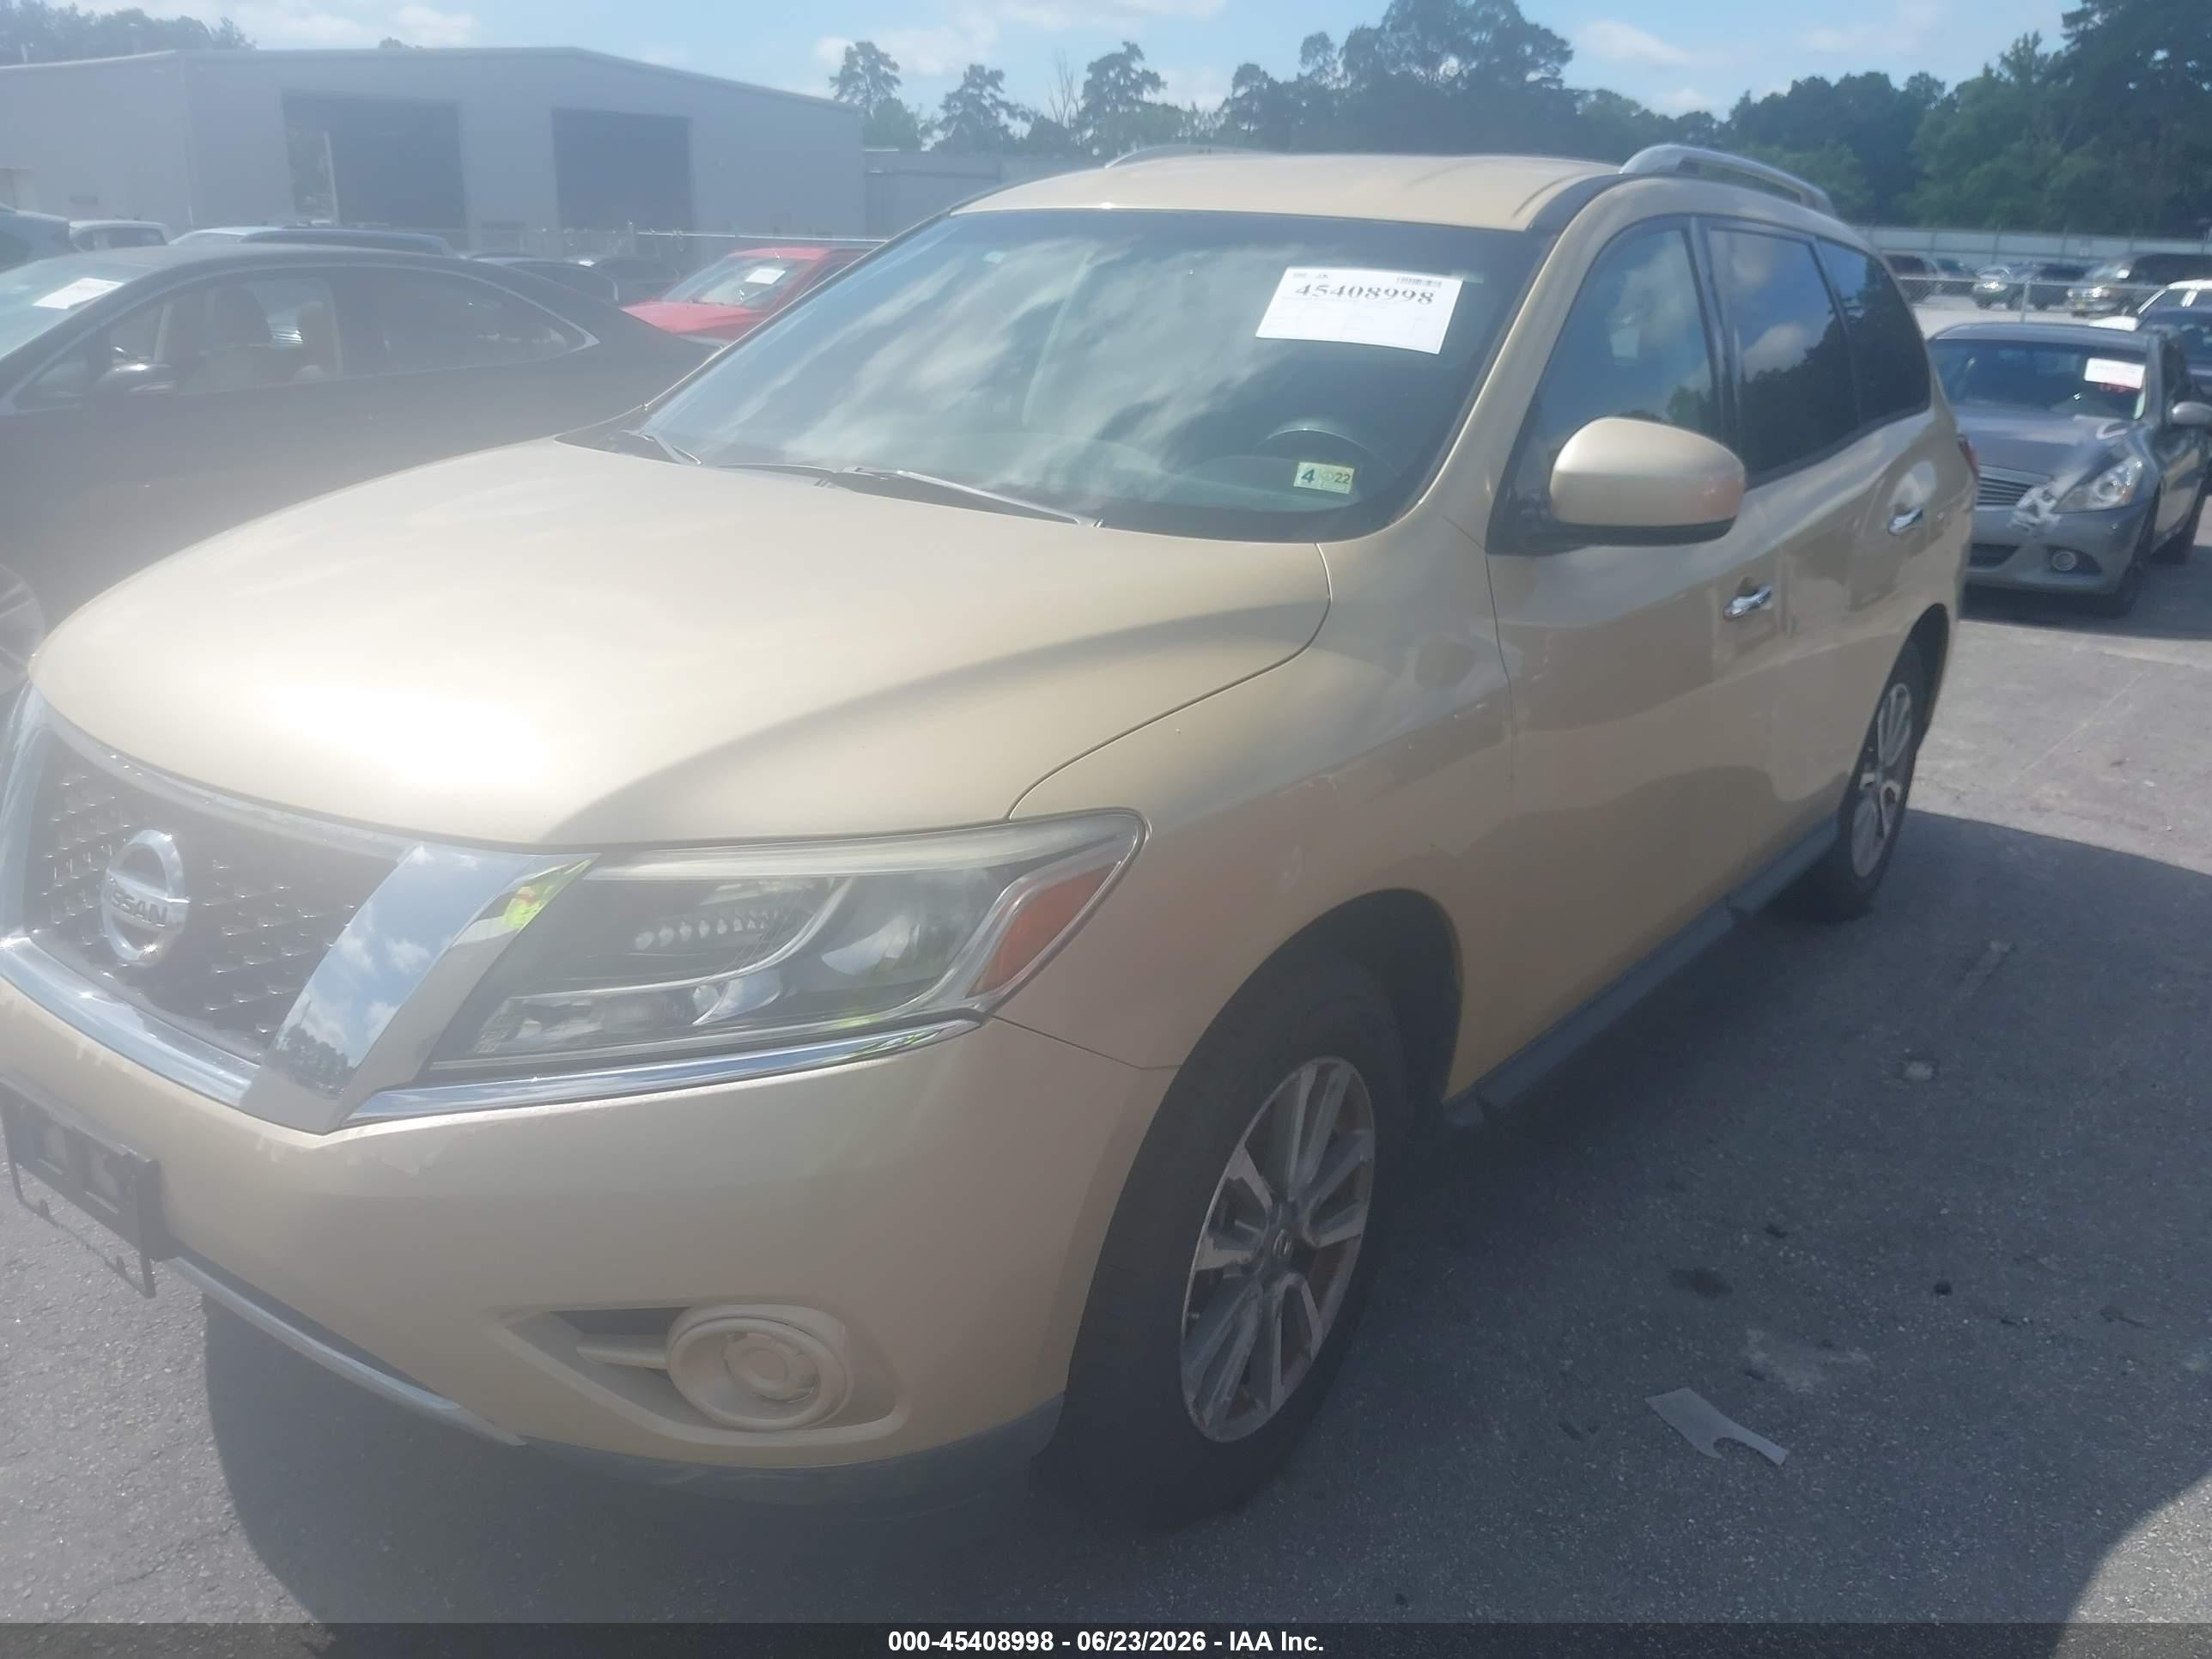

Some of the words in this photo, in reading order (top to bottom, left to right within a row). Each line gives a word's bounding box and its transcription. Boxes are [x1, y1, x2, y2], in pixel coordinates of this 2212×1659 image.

[1295, 284, 1434, 305] 45408998
[1301, 469, 1315, 483] 4
[1334, 472, 1351, 484] 22
